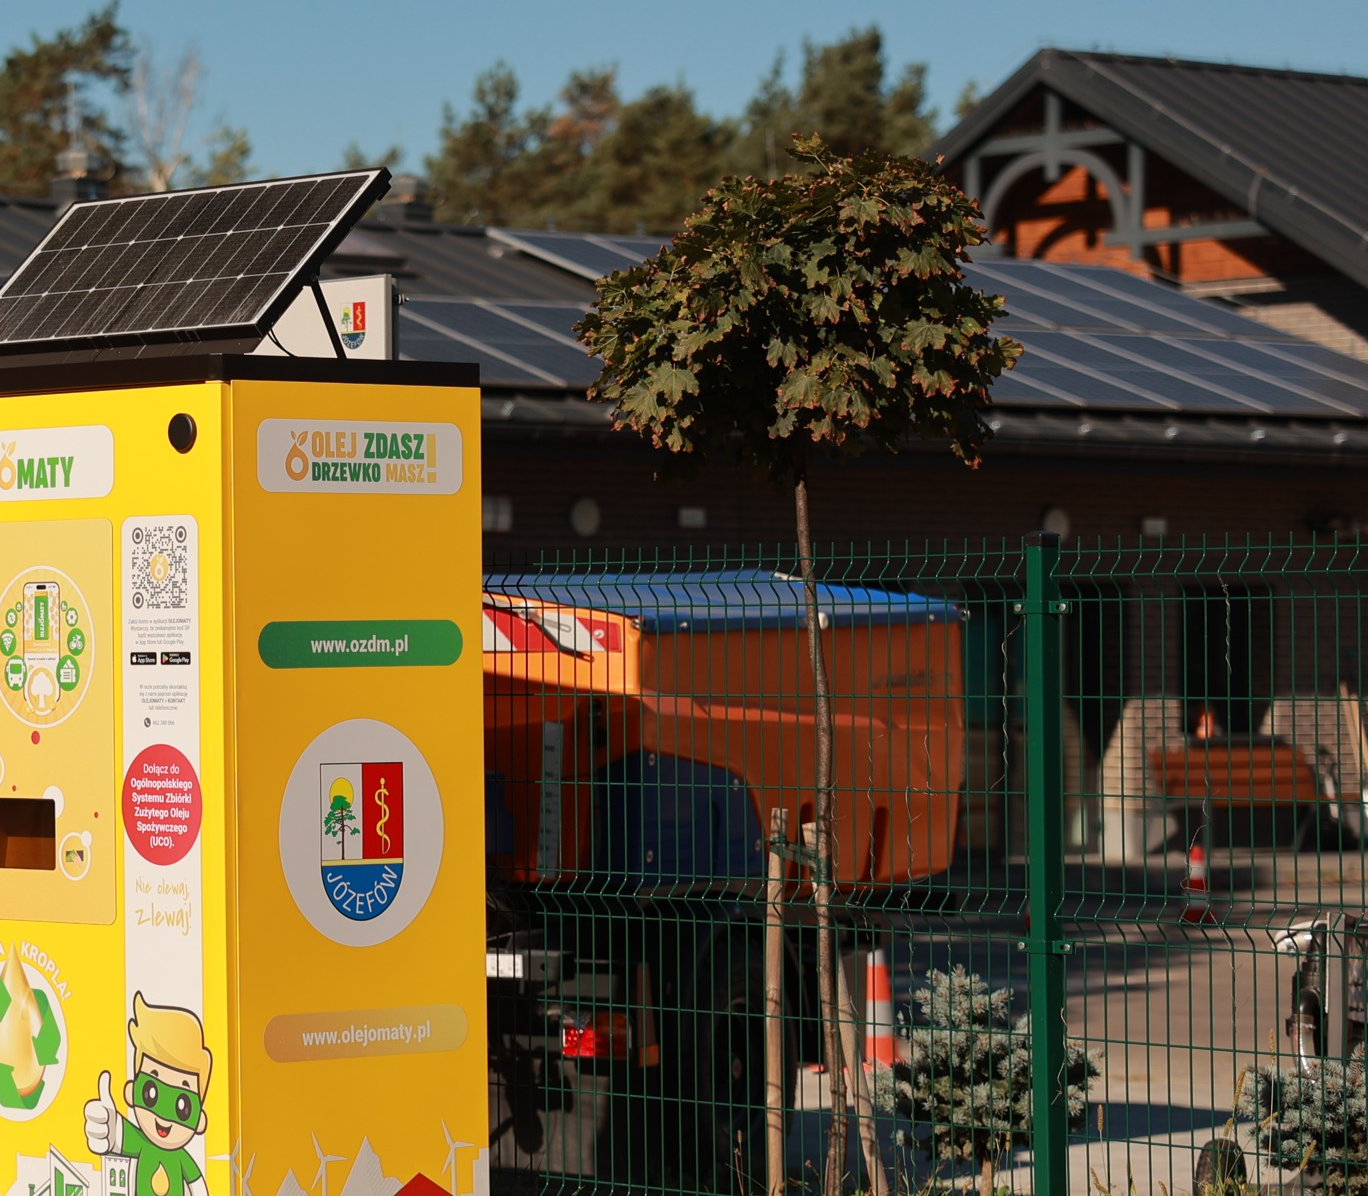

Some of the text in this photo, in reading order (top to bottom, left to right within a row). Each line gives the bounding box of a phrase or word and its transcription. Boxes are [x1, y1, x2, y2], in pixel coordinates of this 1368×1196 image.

[312, 430, 424, 459] OLEJ ZDASZ
[312, 462, 381, 482] DRZEWKO
[311, 634, 408, 656] www.ozdm.pl
[143, 763, 180, 776] Dołącz do
[131, 777, 193, 791] Ogólnopolskiego
[132, 792, 192, 804] Systemu Zbiórki
[134, 806, 190, 820] Zużytego Oleju
[136, 821, 188, 834] Spożywczego
[149, 836, 175, 849] (UCO).
[135, 875, 152, 894] Nie
[326, 864, 398, 914] JÓZEFÓW
[302, 1020, 431, 1047] www.olejomaty.pl
